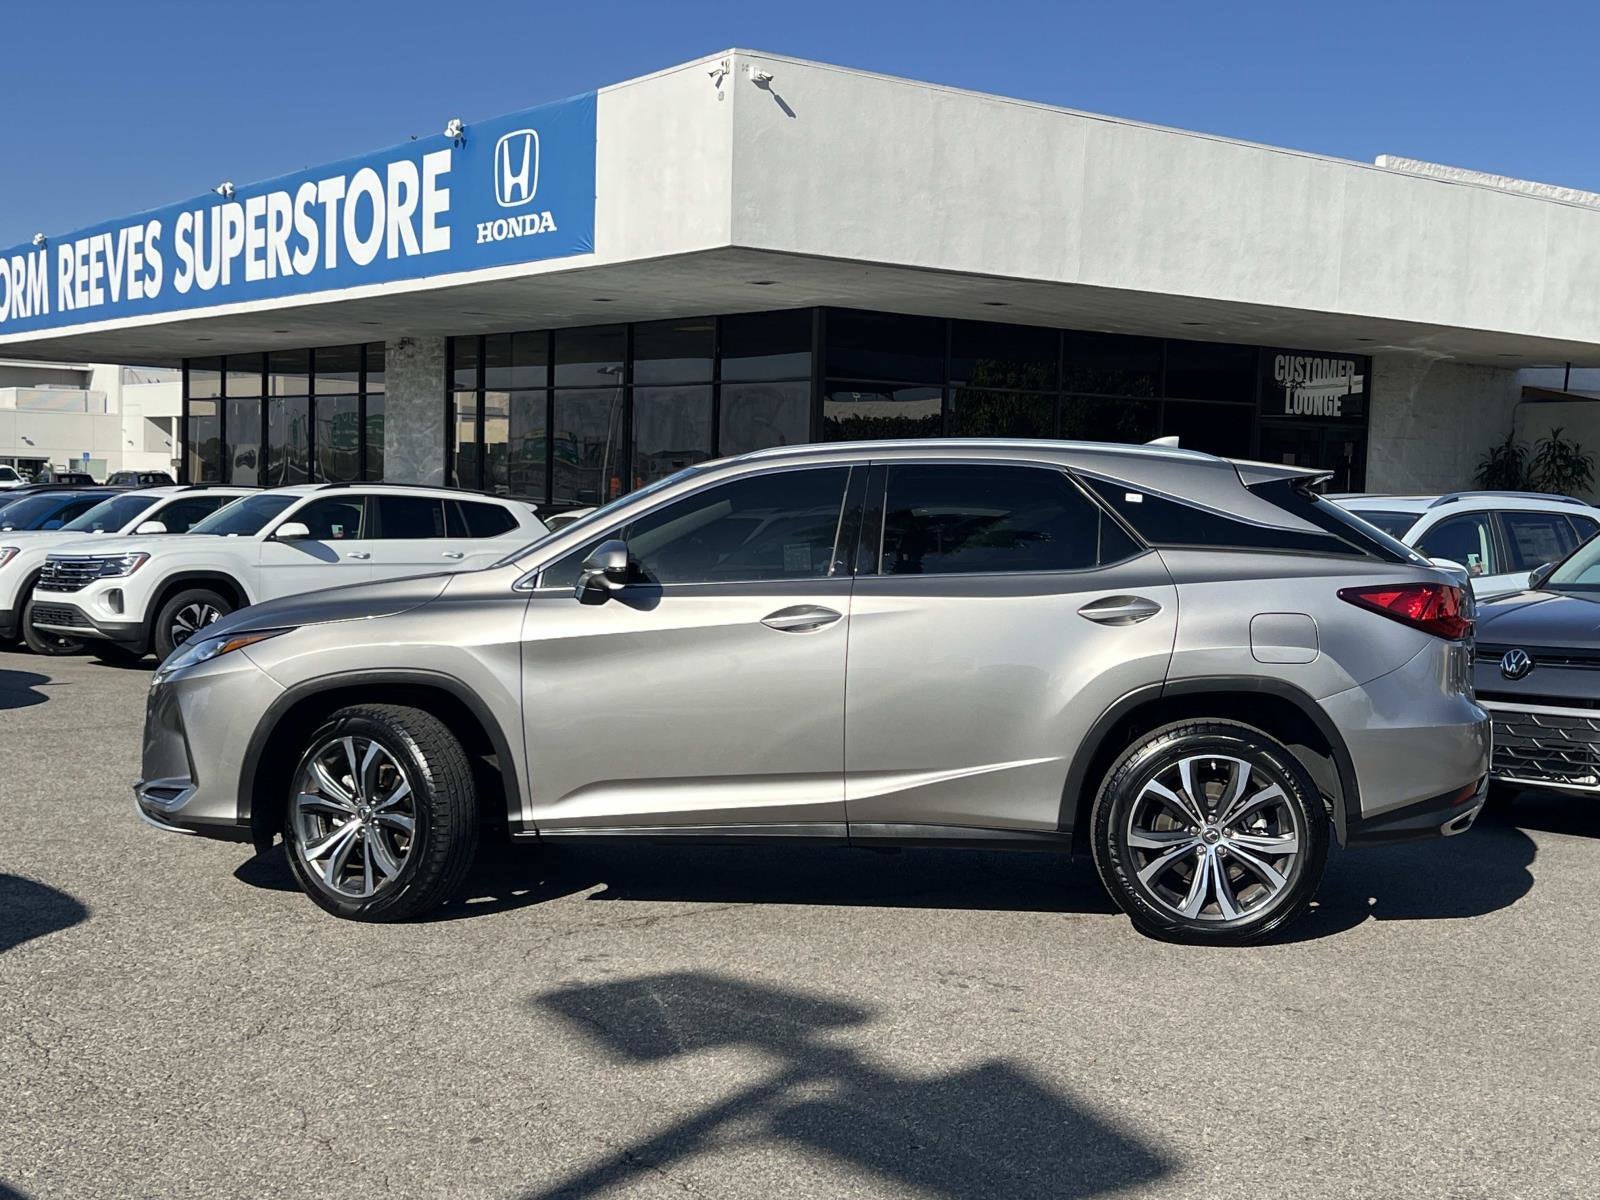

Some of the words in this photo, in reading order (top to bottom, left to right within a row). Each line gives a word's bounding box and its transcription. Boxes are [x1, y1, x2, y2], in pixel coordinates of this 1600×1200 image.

[57, 219, 163, 311] REEVES
[173, 149, 452, 294] SUPERSTORE
[476, 210, 557, 245] HONDA
[1274, 354, 1356, 384] CUSTOMER
[1284, 388, 1342, 417] LOUNGE
